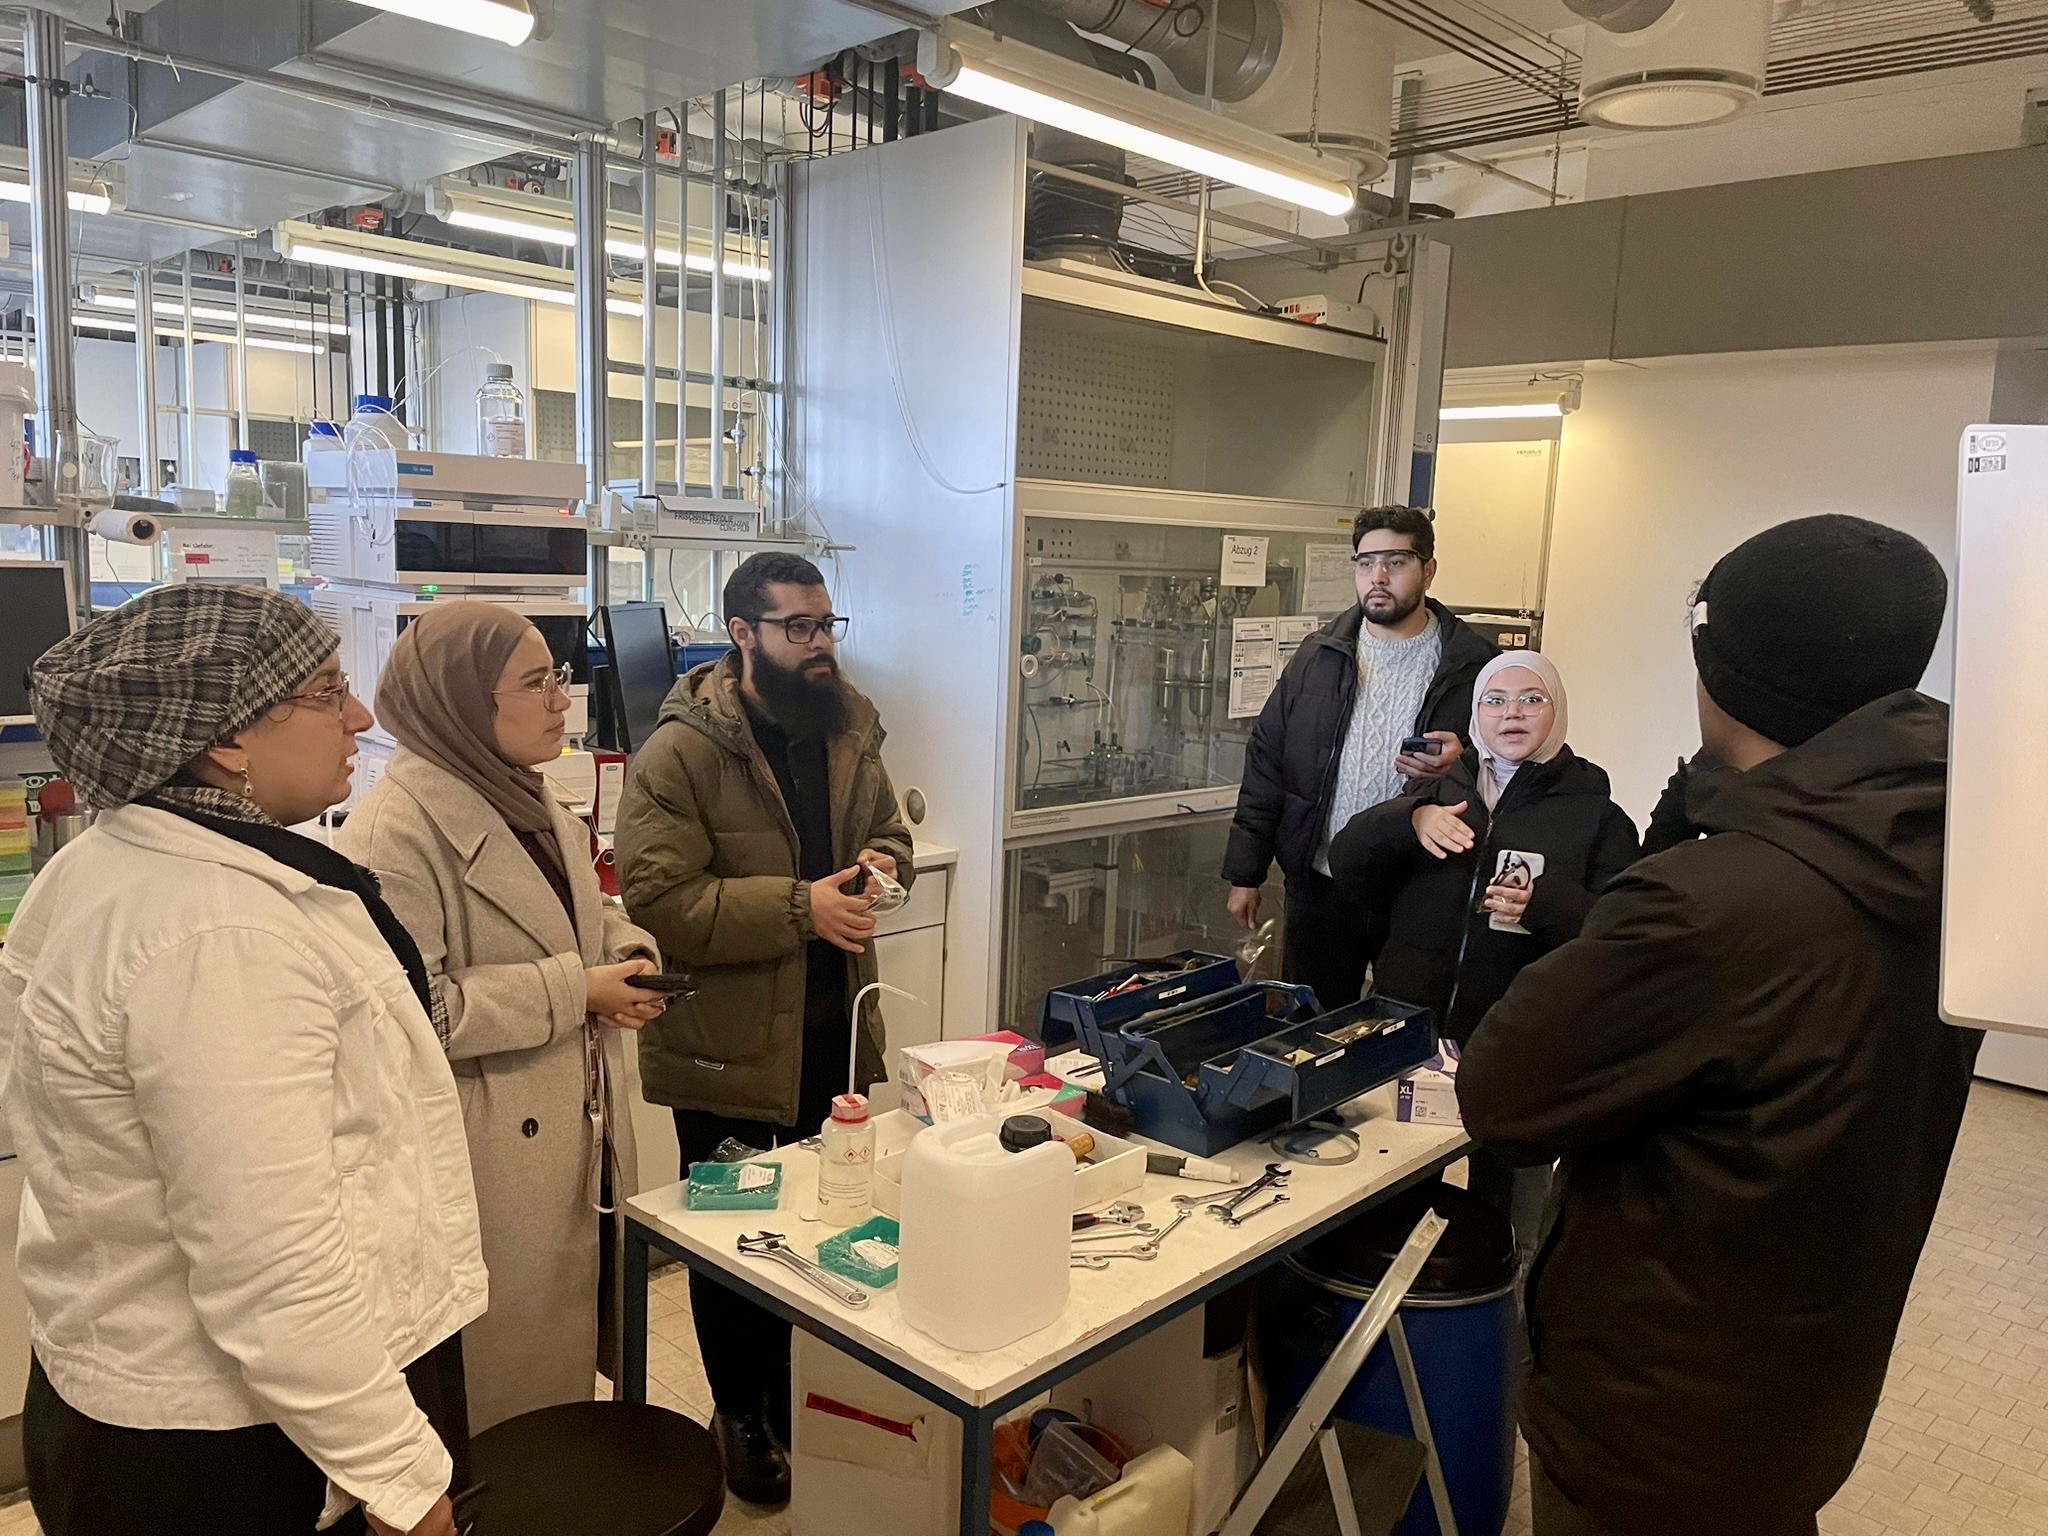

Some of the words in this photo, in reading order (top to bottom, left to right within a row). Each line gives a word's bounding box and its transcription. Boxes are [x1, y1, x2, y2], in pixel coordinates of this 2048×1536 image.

[1232, 545, 1252, 557] Abzug
[1253, 545, 1258, 555] 2
[1399, 1085, 1413, 1095] XL
